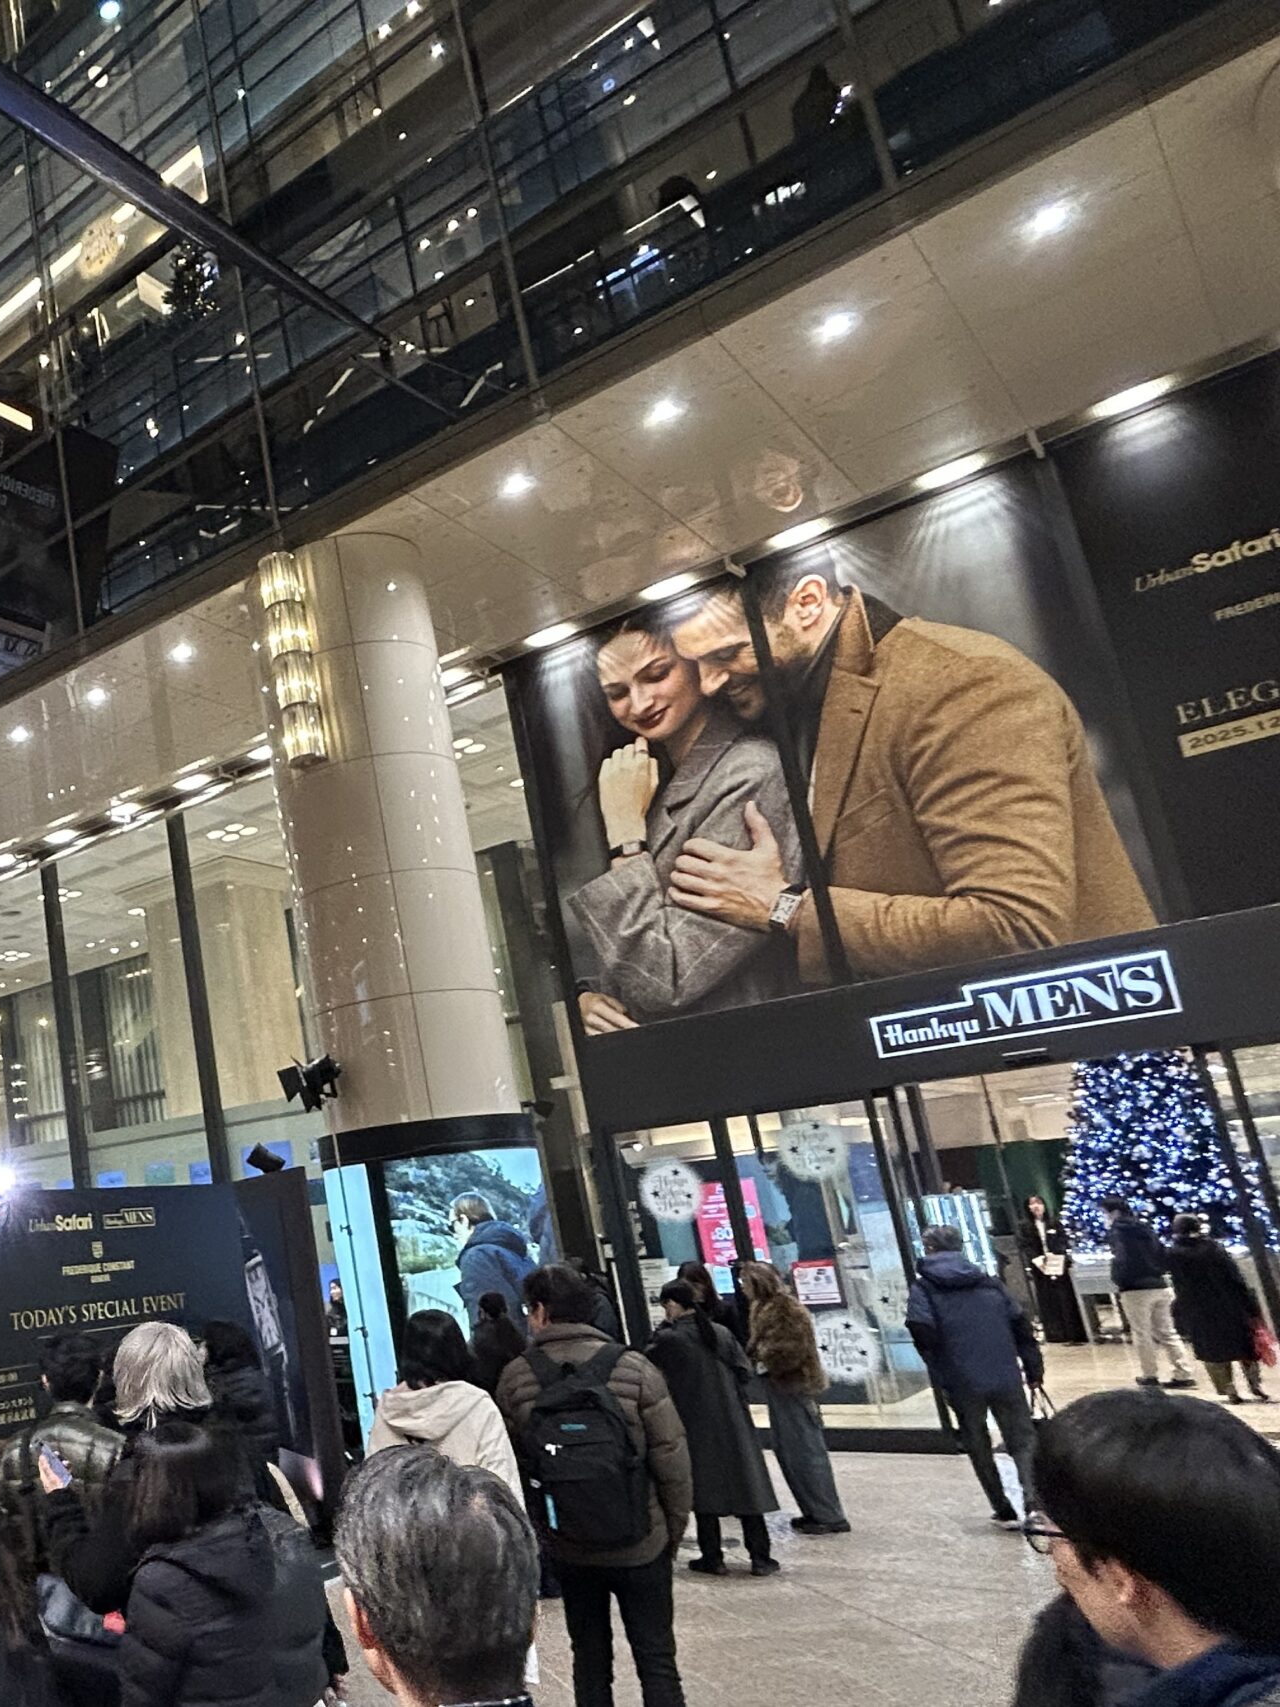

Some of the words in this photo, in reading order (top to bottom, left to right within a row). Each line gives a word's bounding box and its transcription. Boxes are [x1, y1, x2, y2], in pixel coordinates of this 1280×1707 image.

[883, 1016, 981, 1048] Hankyu
[10, 1304, 77, 1331] TODAY'S
[82, 1298, 139, 1322] SPECIAL
[143, 1292, 186, 1314] EVENT
